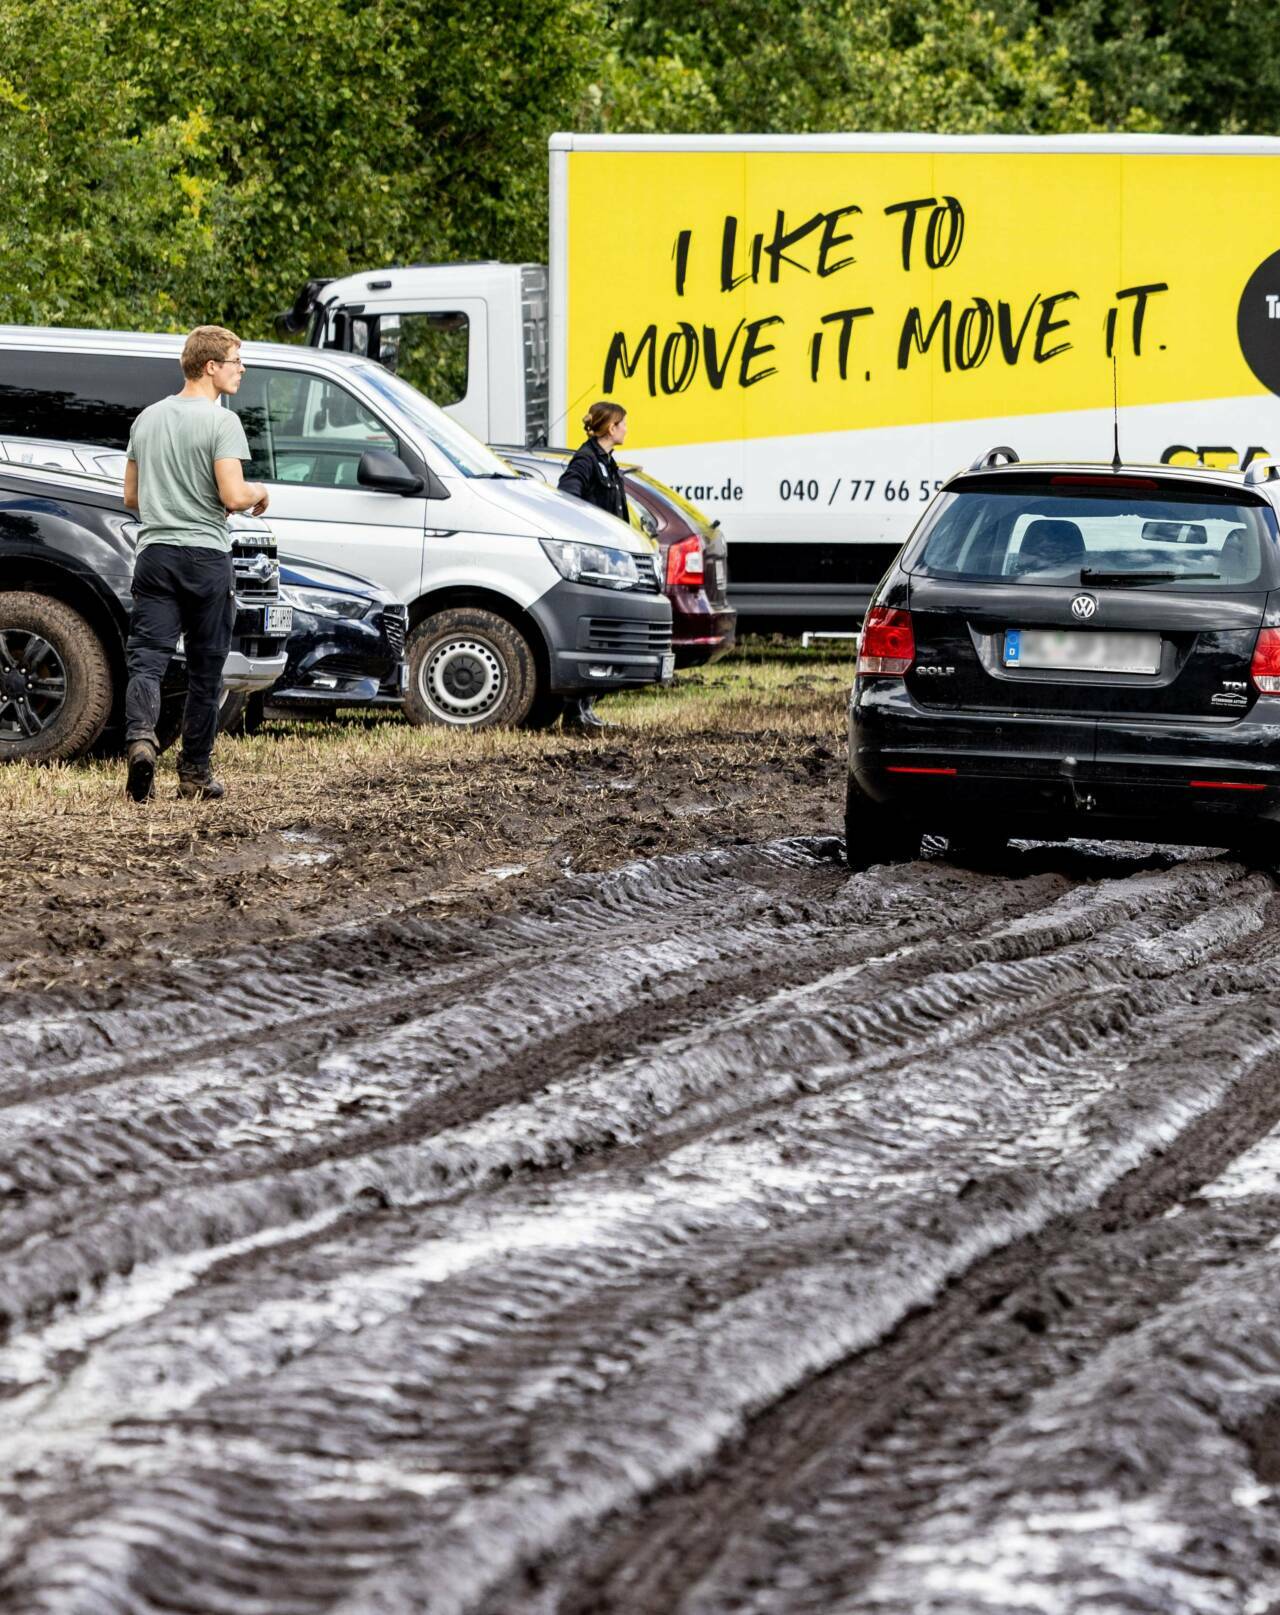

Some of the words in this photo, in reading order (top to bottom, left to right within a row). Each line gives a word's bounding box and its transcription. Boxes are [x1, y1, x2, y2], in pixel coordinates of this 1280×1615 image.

[671, 229, 692, 297] I
[720, 204, 863, 293] LIKE
[883, 195, 965, 272] TO
[602, 314, 785, 397] MOVE
[896, 290, 1081, 373] MOVE
[779, 479, 820, 501] 040
[850, 479, 876, 501] 77
[884, 479, 910, 501] 66
[916, 666, 955, 676] GOLF
[1223, 681, 1247, 691] TDI
